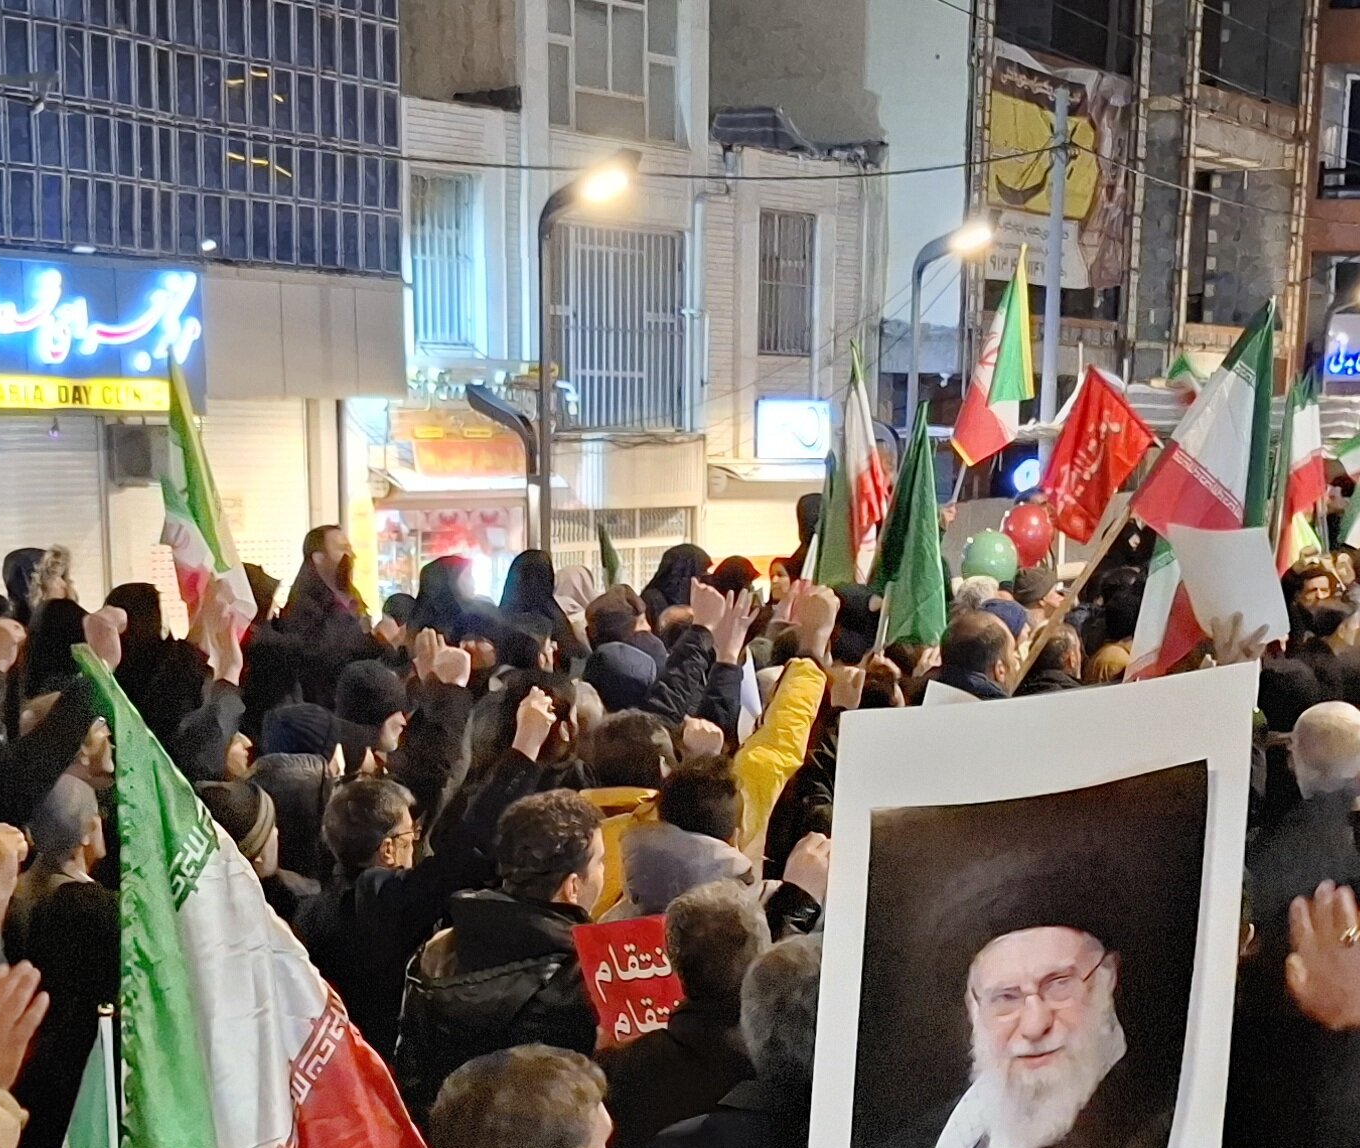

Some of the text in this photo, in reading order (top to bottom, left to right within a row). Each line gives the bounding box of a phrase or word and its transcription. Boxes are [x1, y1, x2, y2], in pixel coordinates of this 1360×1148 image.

[58, 385, 92, 406] DAY
[594, 943, 673, 1004] نتقام
[614, 998, 680, 1042] تقام
